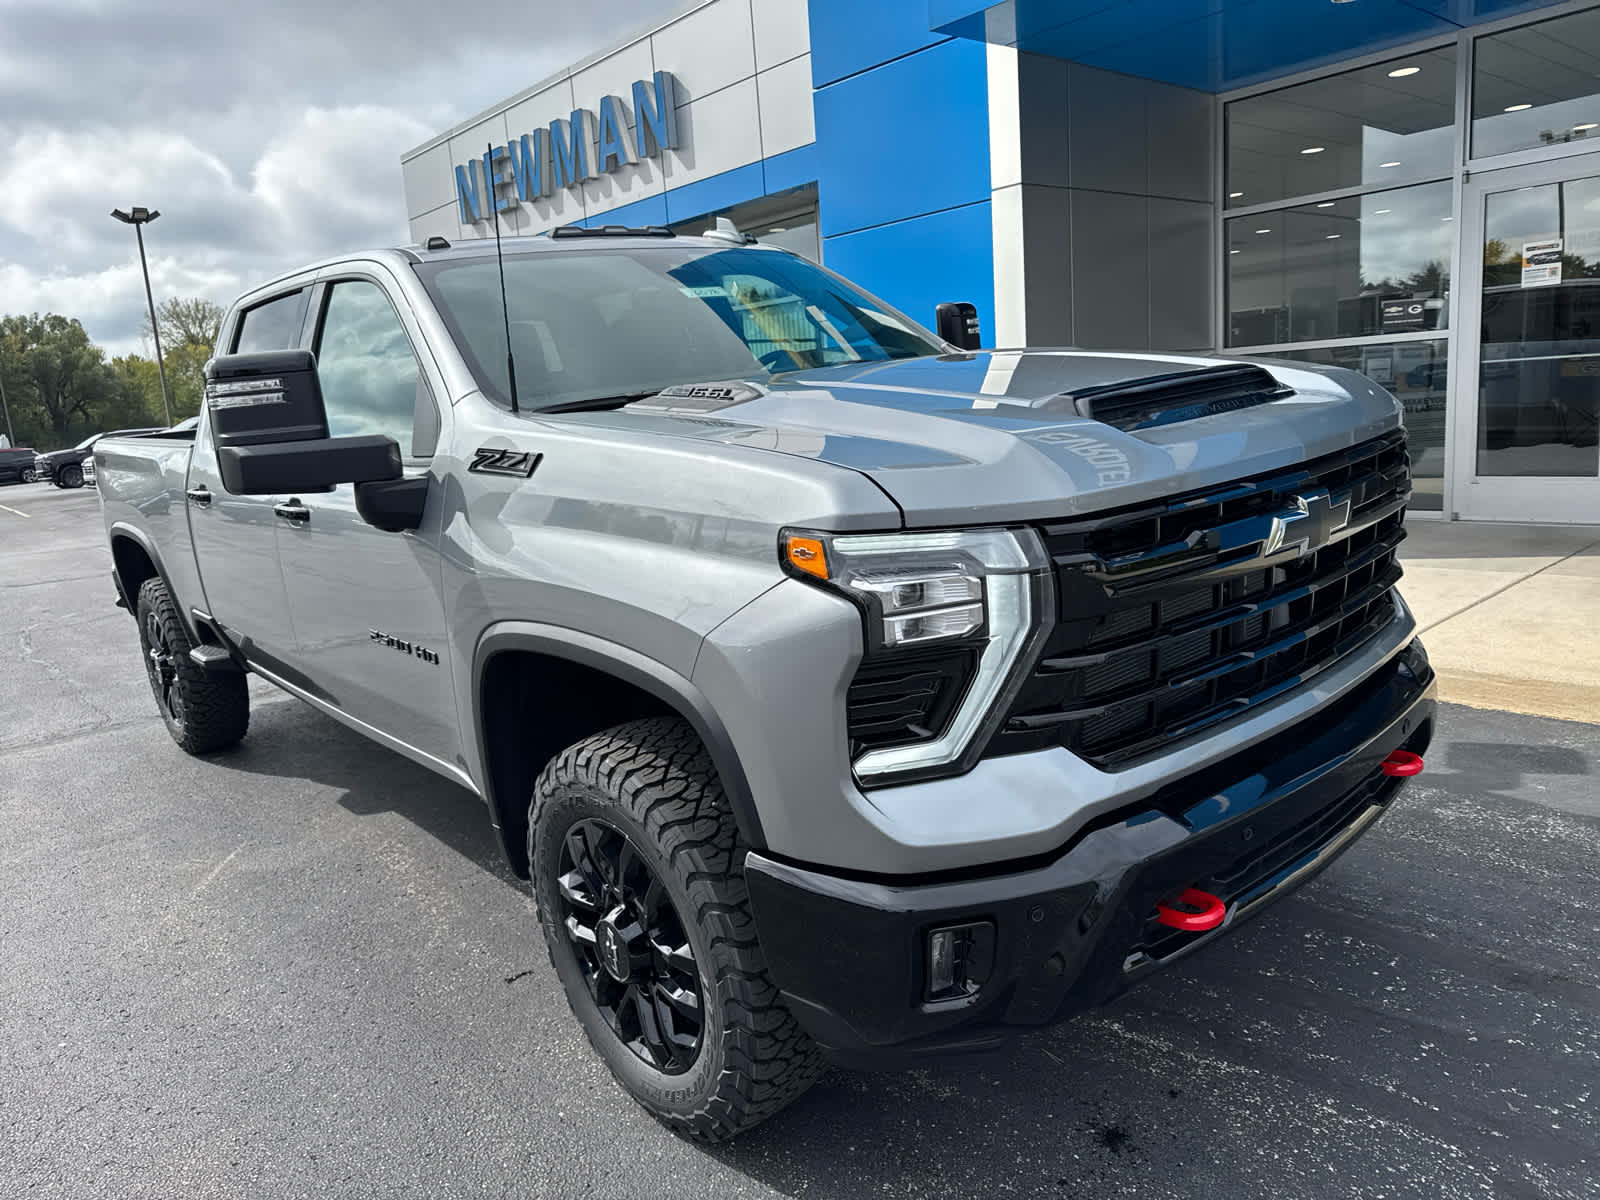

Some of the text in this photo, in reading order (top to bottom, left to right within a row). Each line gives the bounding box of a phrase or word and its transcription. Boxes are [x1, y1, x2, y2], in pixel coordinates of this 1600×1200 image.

[455, 70, 679, 225] NEWMAN
[467, 448, 545, 479] Z71
[413, 645, 440, 666] HD
